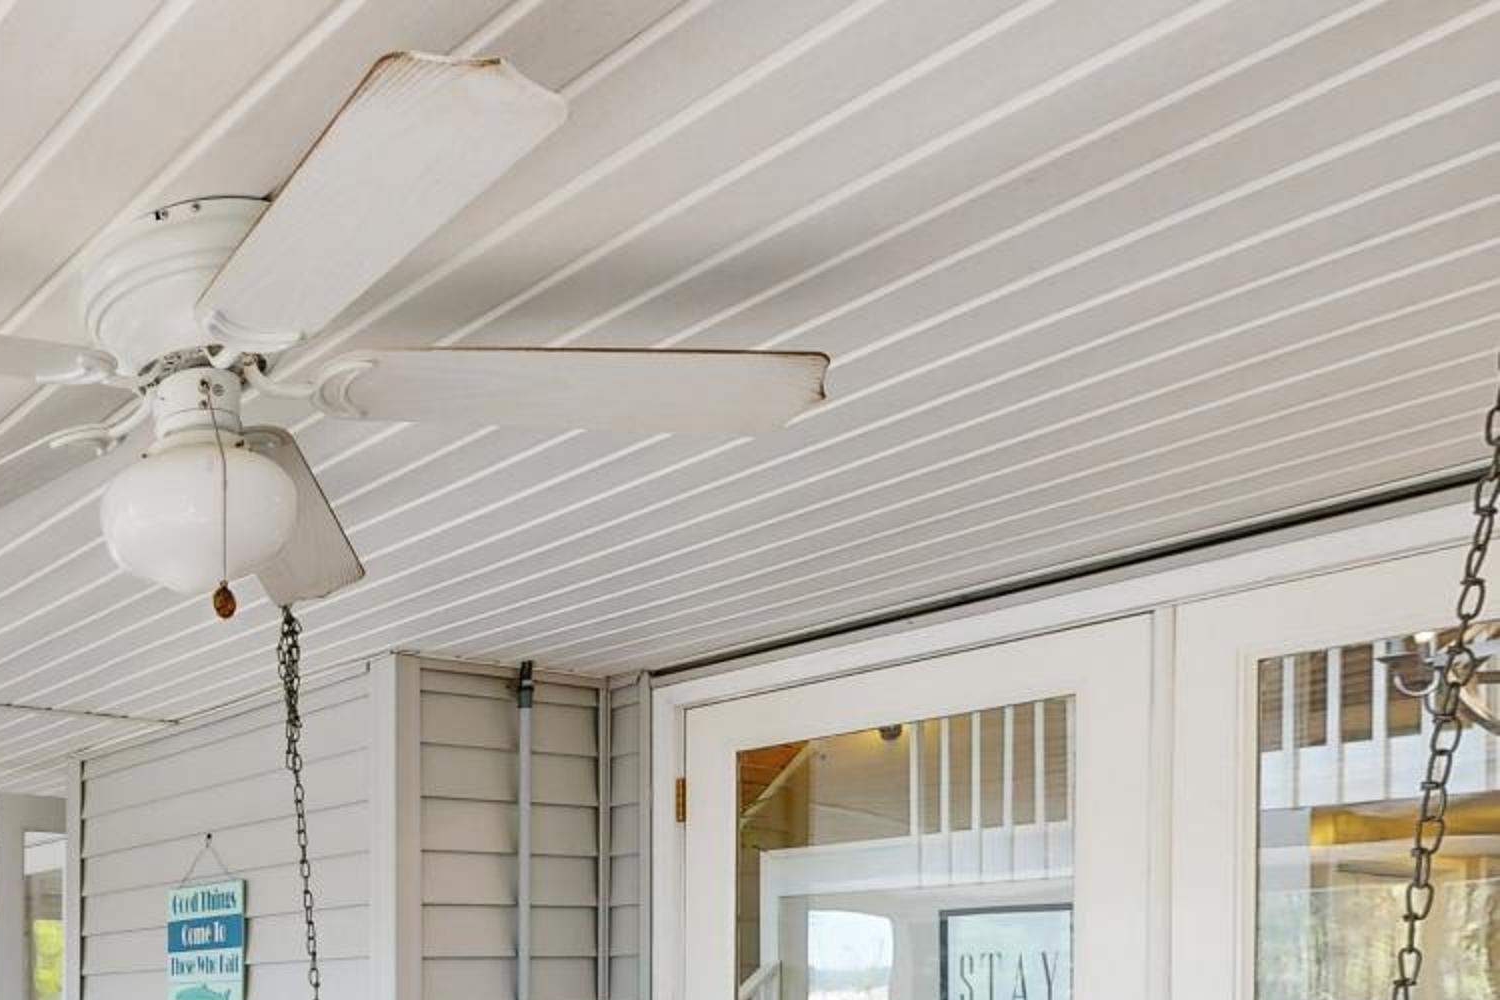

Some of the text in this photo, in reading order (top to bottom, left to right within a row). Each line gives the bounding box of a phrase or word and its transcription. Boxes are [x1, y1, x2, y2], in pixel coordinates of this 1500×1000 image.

[172, 886, 237, 915] Good Things
[181, 920, 227, 948] Come To
